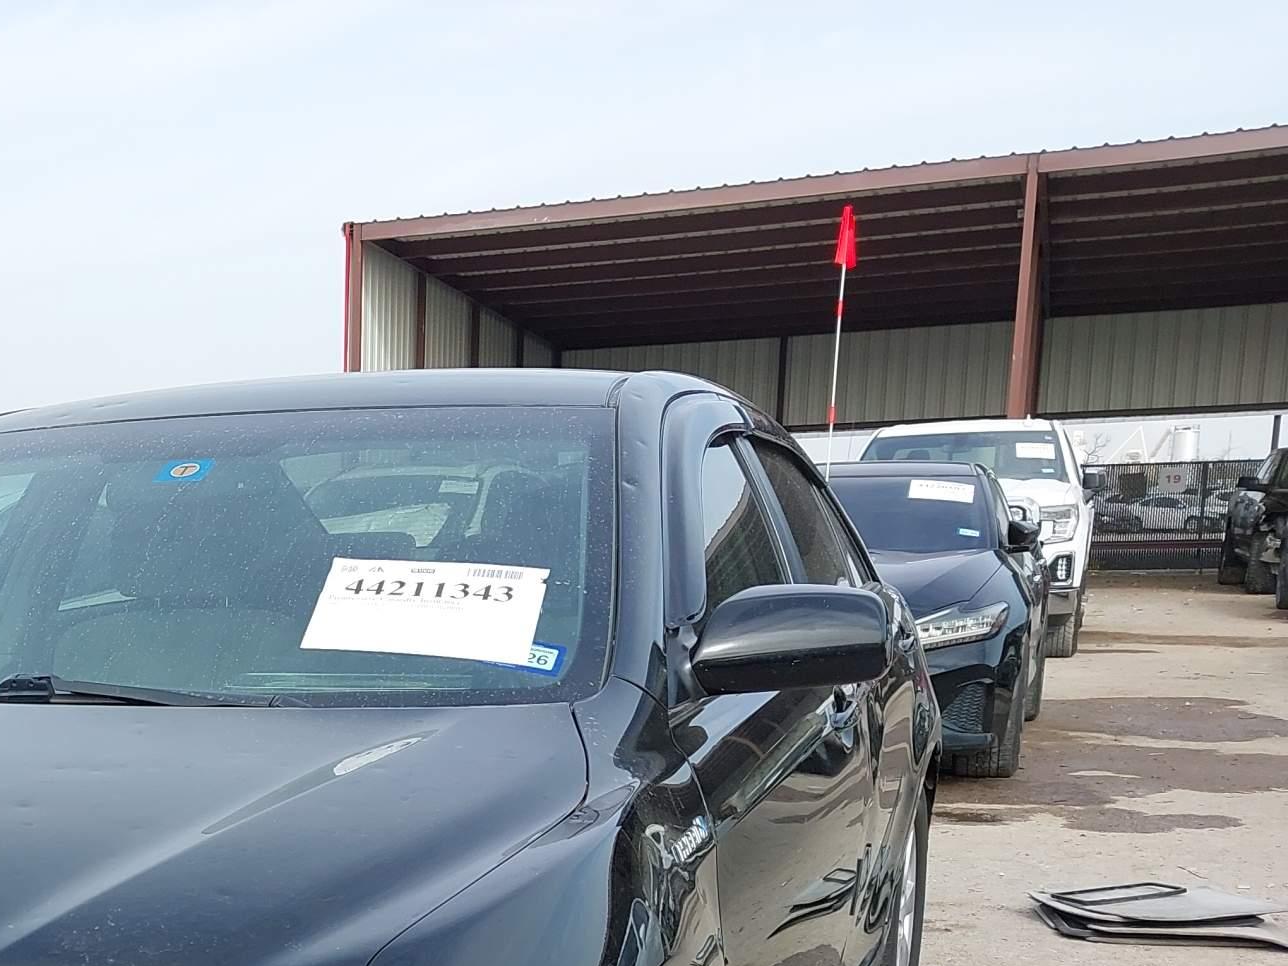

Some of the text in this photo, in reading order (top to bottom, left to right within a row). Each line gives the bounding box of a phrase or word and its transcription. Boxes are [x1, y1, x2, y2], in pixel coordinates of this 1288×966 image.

[1165, 474, 1182, 484] 19
[344, 578, 514, 603] 44211343
[527, 652, 550, 666] 26
